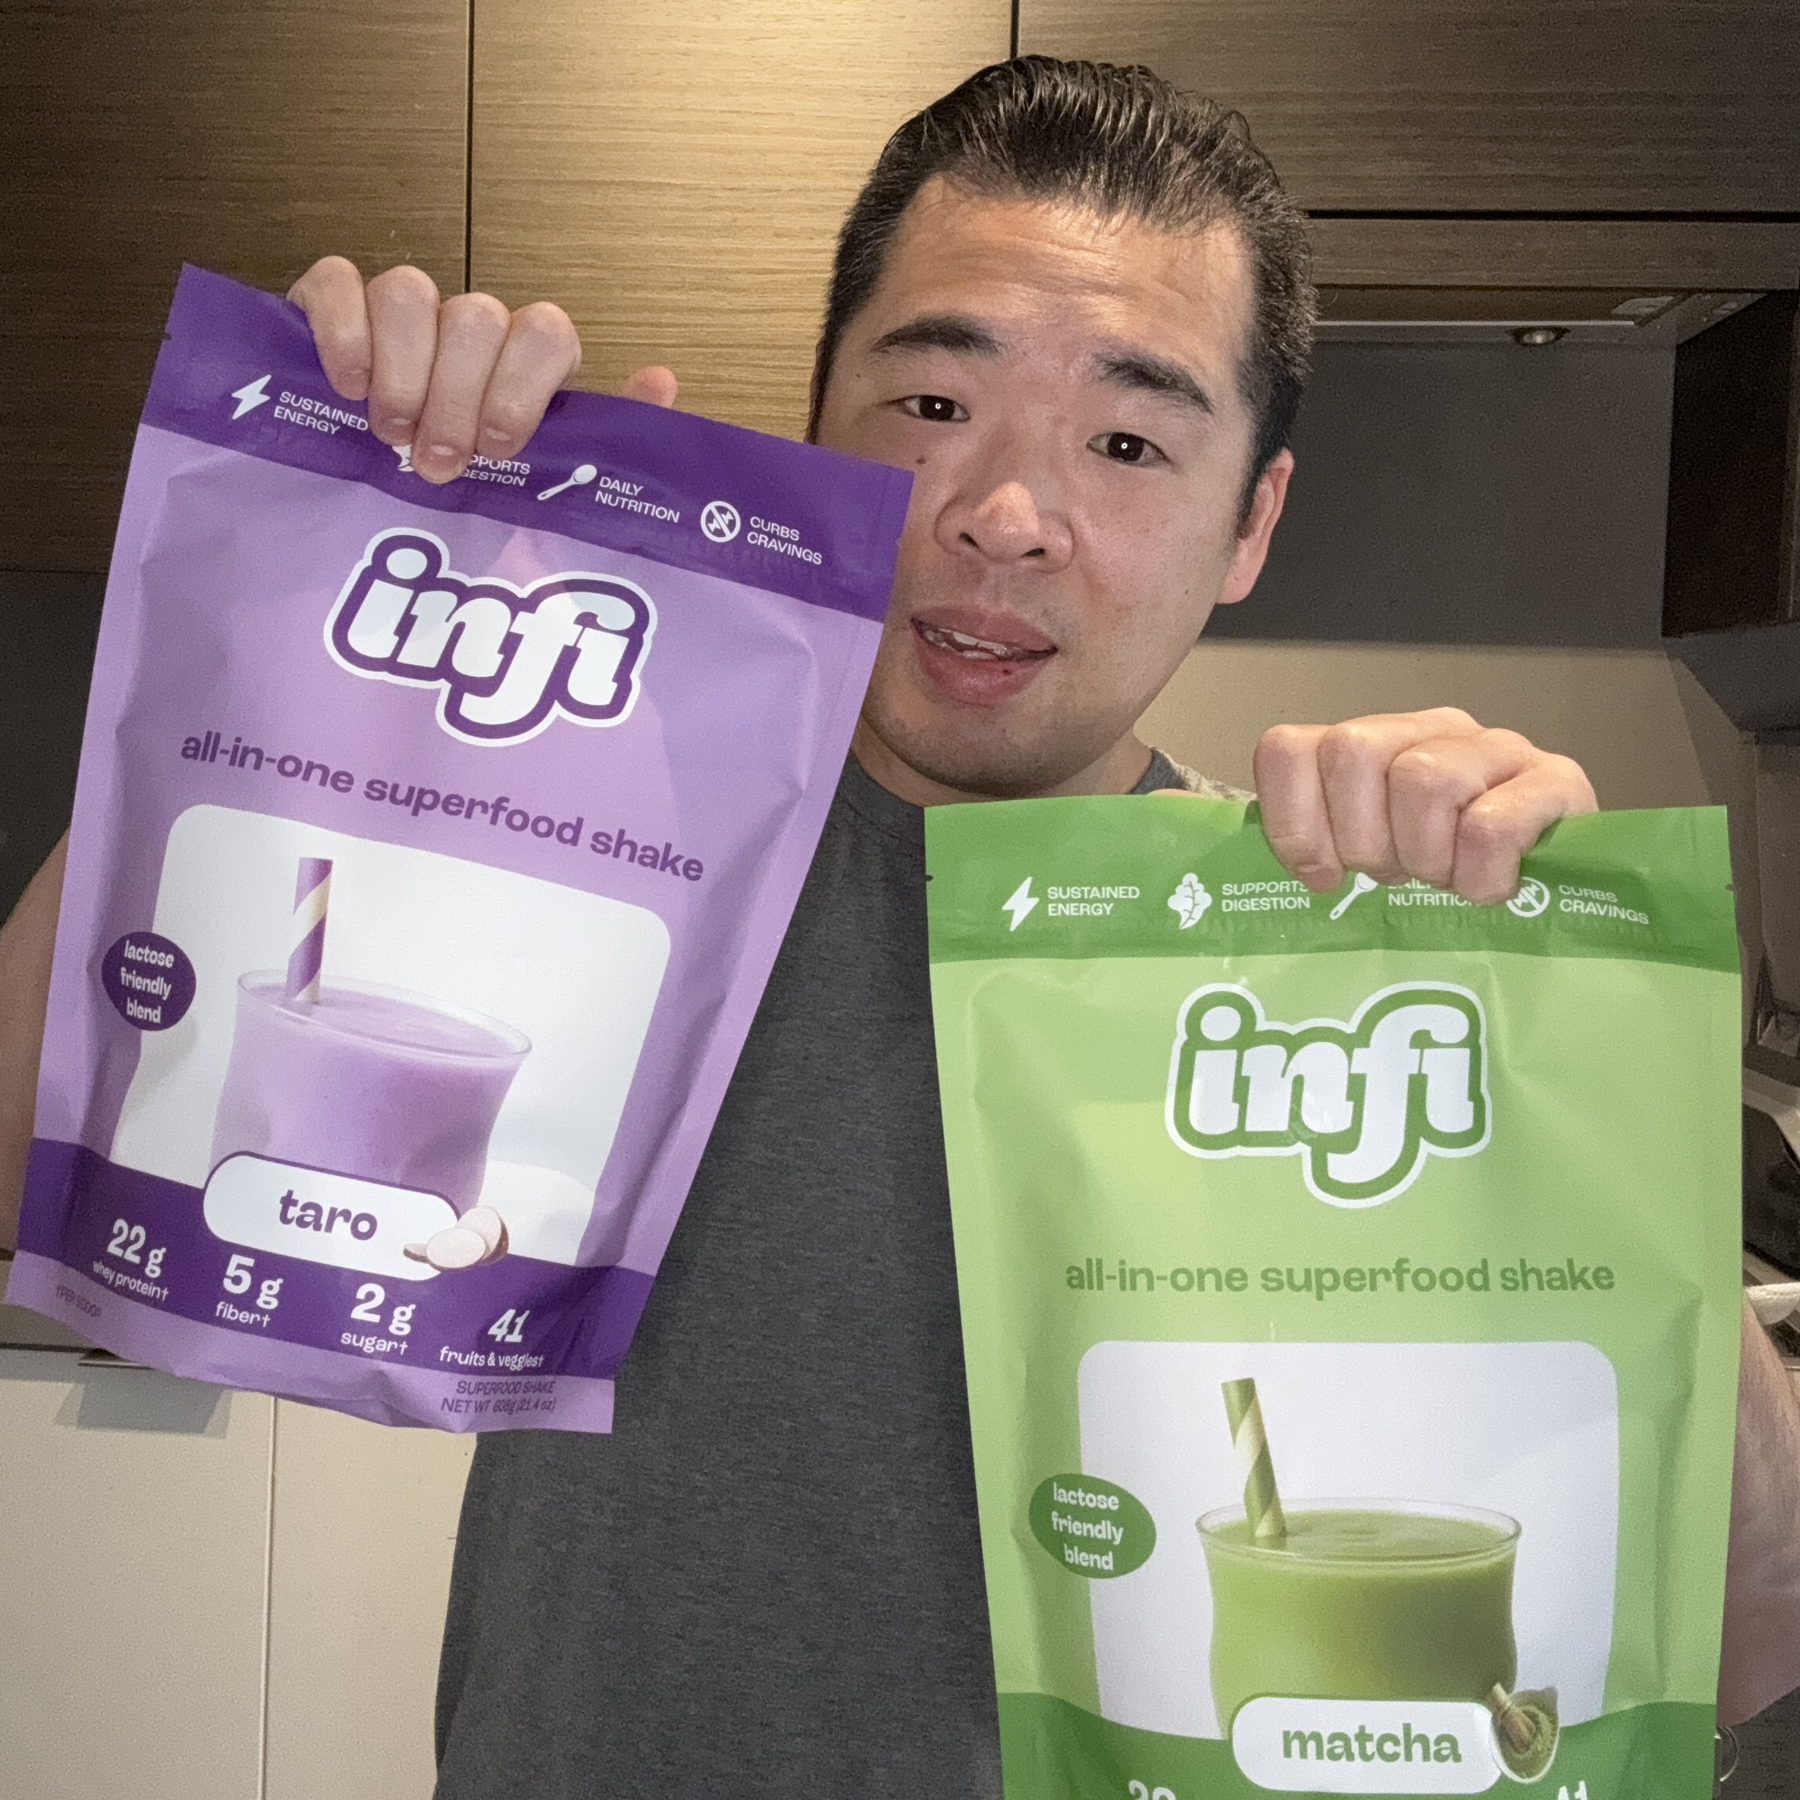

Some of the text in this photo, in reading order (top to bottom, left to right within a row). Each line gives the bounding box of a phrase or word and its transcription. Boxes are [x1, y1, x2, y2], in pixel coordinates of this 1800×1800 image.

[273, 406, 340, 435] ENERGY
[279, 391, 369, 432] SUSTAINED
[599, 476, 643, 497] DAILY
[595, 490, 680, 523] NUTRITION
[750, 516, 800, 541] CURBS
[747, 532, 823, 565] CRAVINGS
[326, 530, 656, 745] infi
[180, 730, 704, 882] all-in-one superfood shake
[1047, 886, 1140, 899] SUSTAINED
[1221, 896, 1311, 912] DIGESTION
[1388, 893, 1472, 906] NUTRITIO
[1558, 884, 1618, 903] CURBS
[1048, 902, 1114, 917] ENERGY
[1559, 898, 1649, 925] CRAVINGS
[124, 940, 175, 968] lactose
[120, 967, 172, 1000] friendly
[126, 997, 161, 1024] blend
[1168, 984, 1489, 1205] infi
[279, 1189, 378, 1241] taro
[107, 1218, 167, 1278] 22 g
[92, 1260, 115, 1285] whey
[222, 1254, 283, 1310] 5 g
[1065, 1257, 1616, 1301] all-in-one superfood shake
[350, 1283, 416, 1336] 2 g
[487, 1309, 530, 1343] 41
[439, 1345, 486, 1367] fruits
[487, 1352, 496, 1367] &
[456, 1380, 556, 1395] SUPERFOOD SHAKE
[440, 1398, 472, 1413] NET
[473, 1400, 491, 1413] WT
[1053, 1481, 1120, 1511] lactose
[1051, 1510, 1124, 1546] friendly
[1063, 1543, 1114, 1571] blend
[1281, 1722, 1463, 1765] matcha
